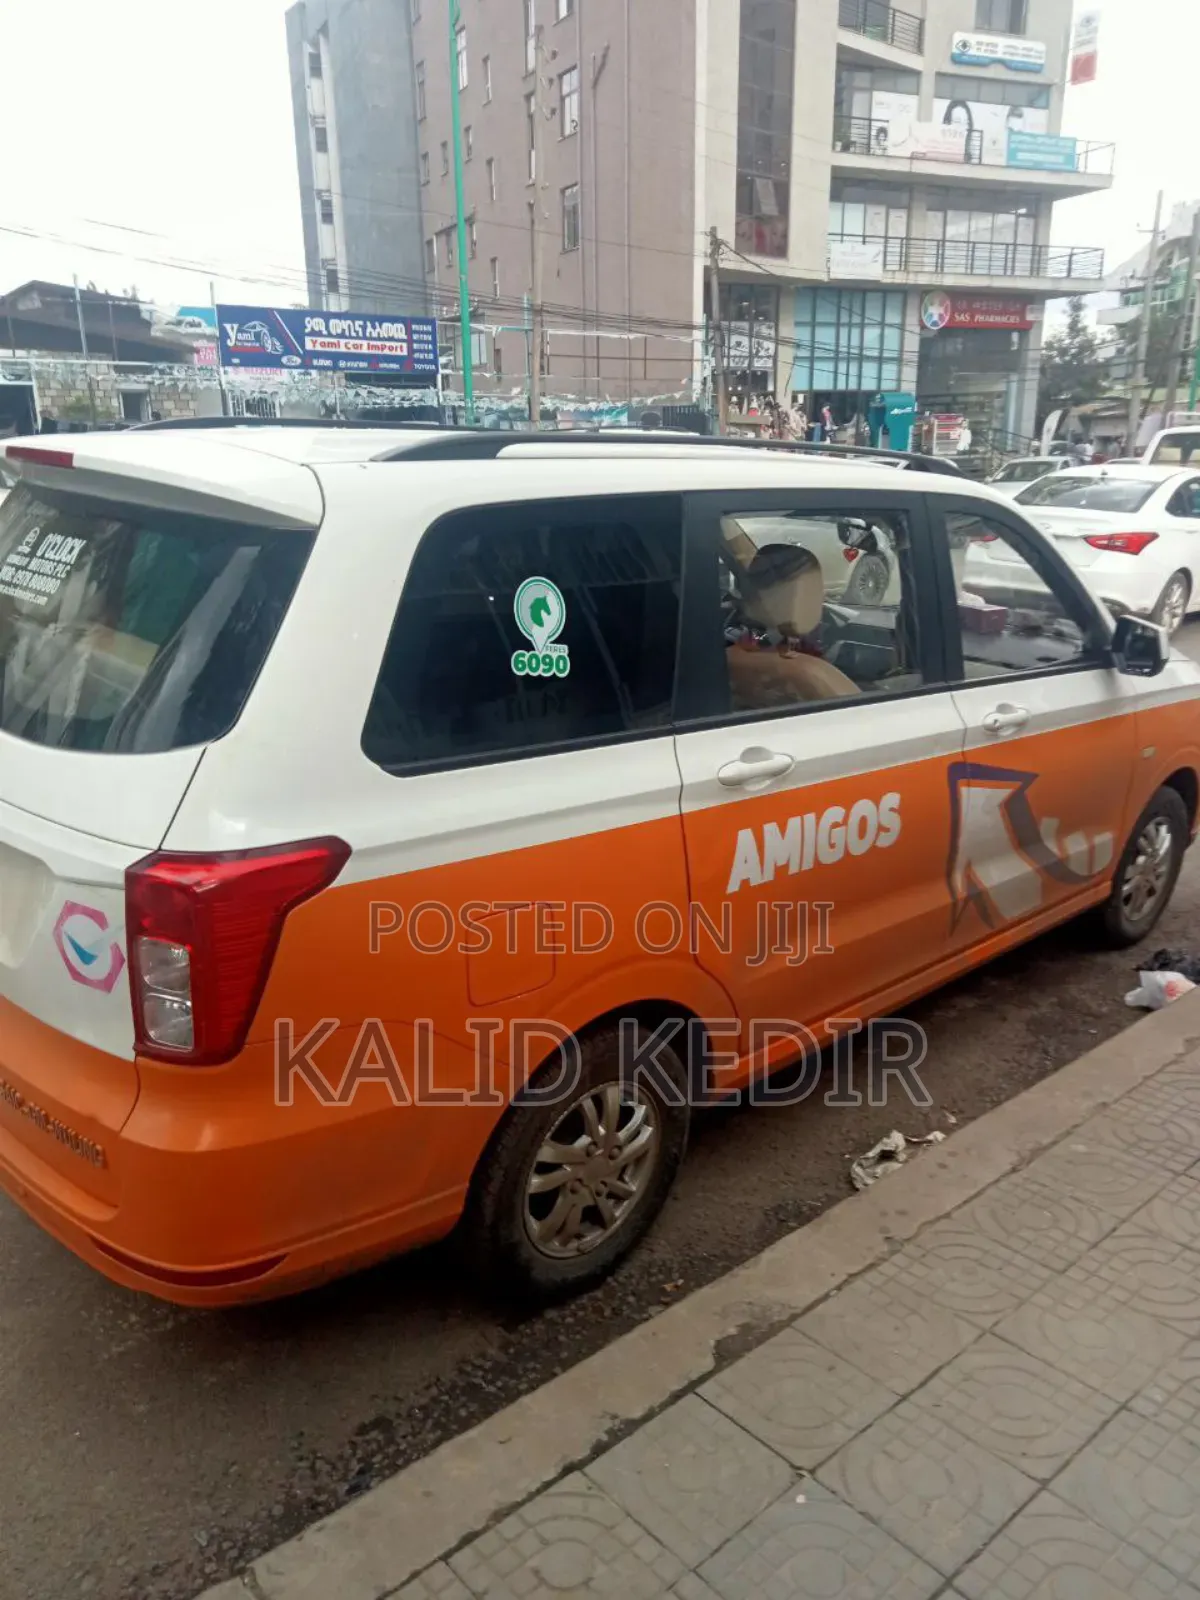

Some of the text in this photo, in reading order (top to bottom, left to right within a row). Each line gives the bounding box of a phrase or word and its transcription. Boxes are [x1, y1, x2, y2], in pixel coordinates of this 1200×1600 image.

[953, 312, 971, 323] SAS
[310, 338, 341, 351] Yami
[344, 340, 364, 351] Car
[35, 532, 87, 566] O'CLOCK
[52, 562, 71, 578] PLC
[512, 652, 569, 677] 6090
[726, 792, 902, 895] AMIGOS
